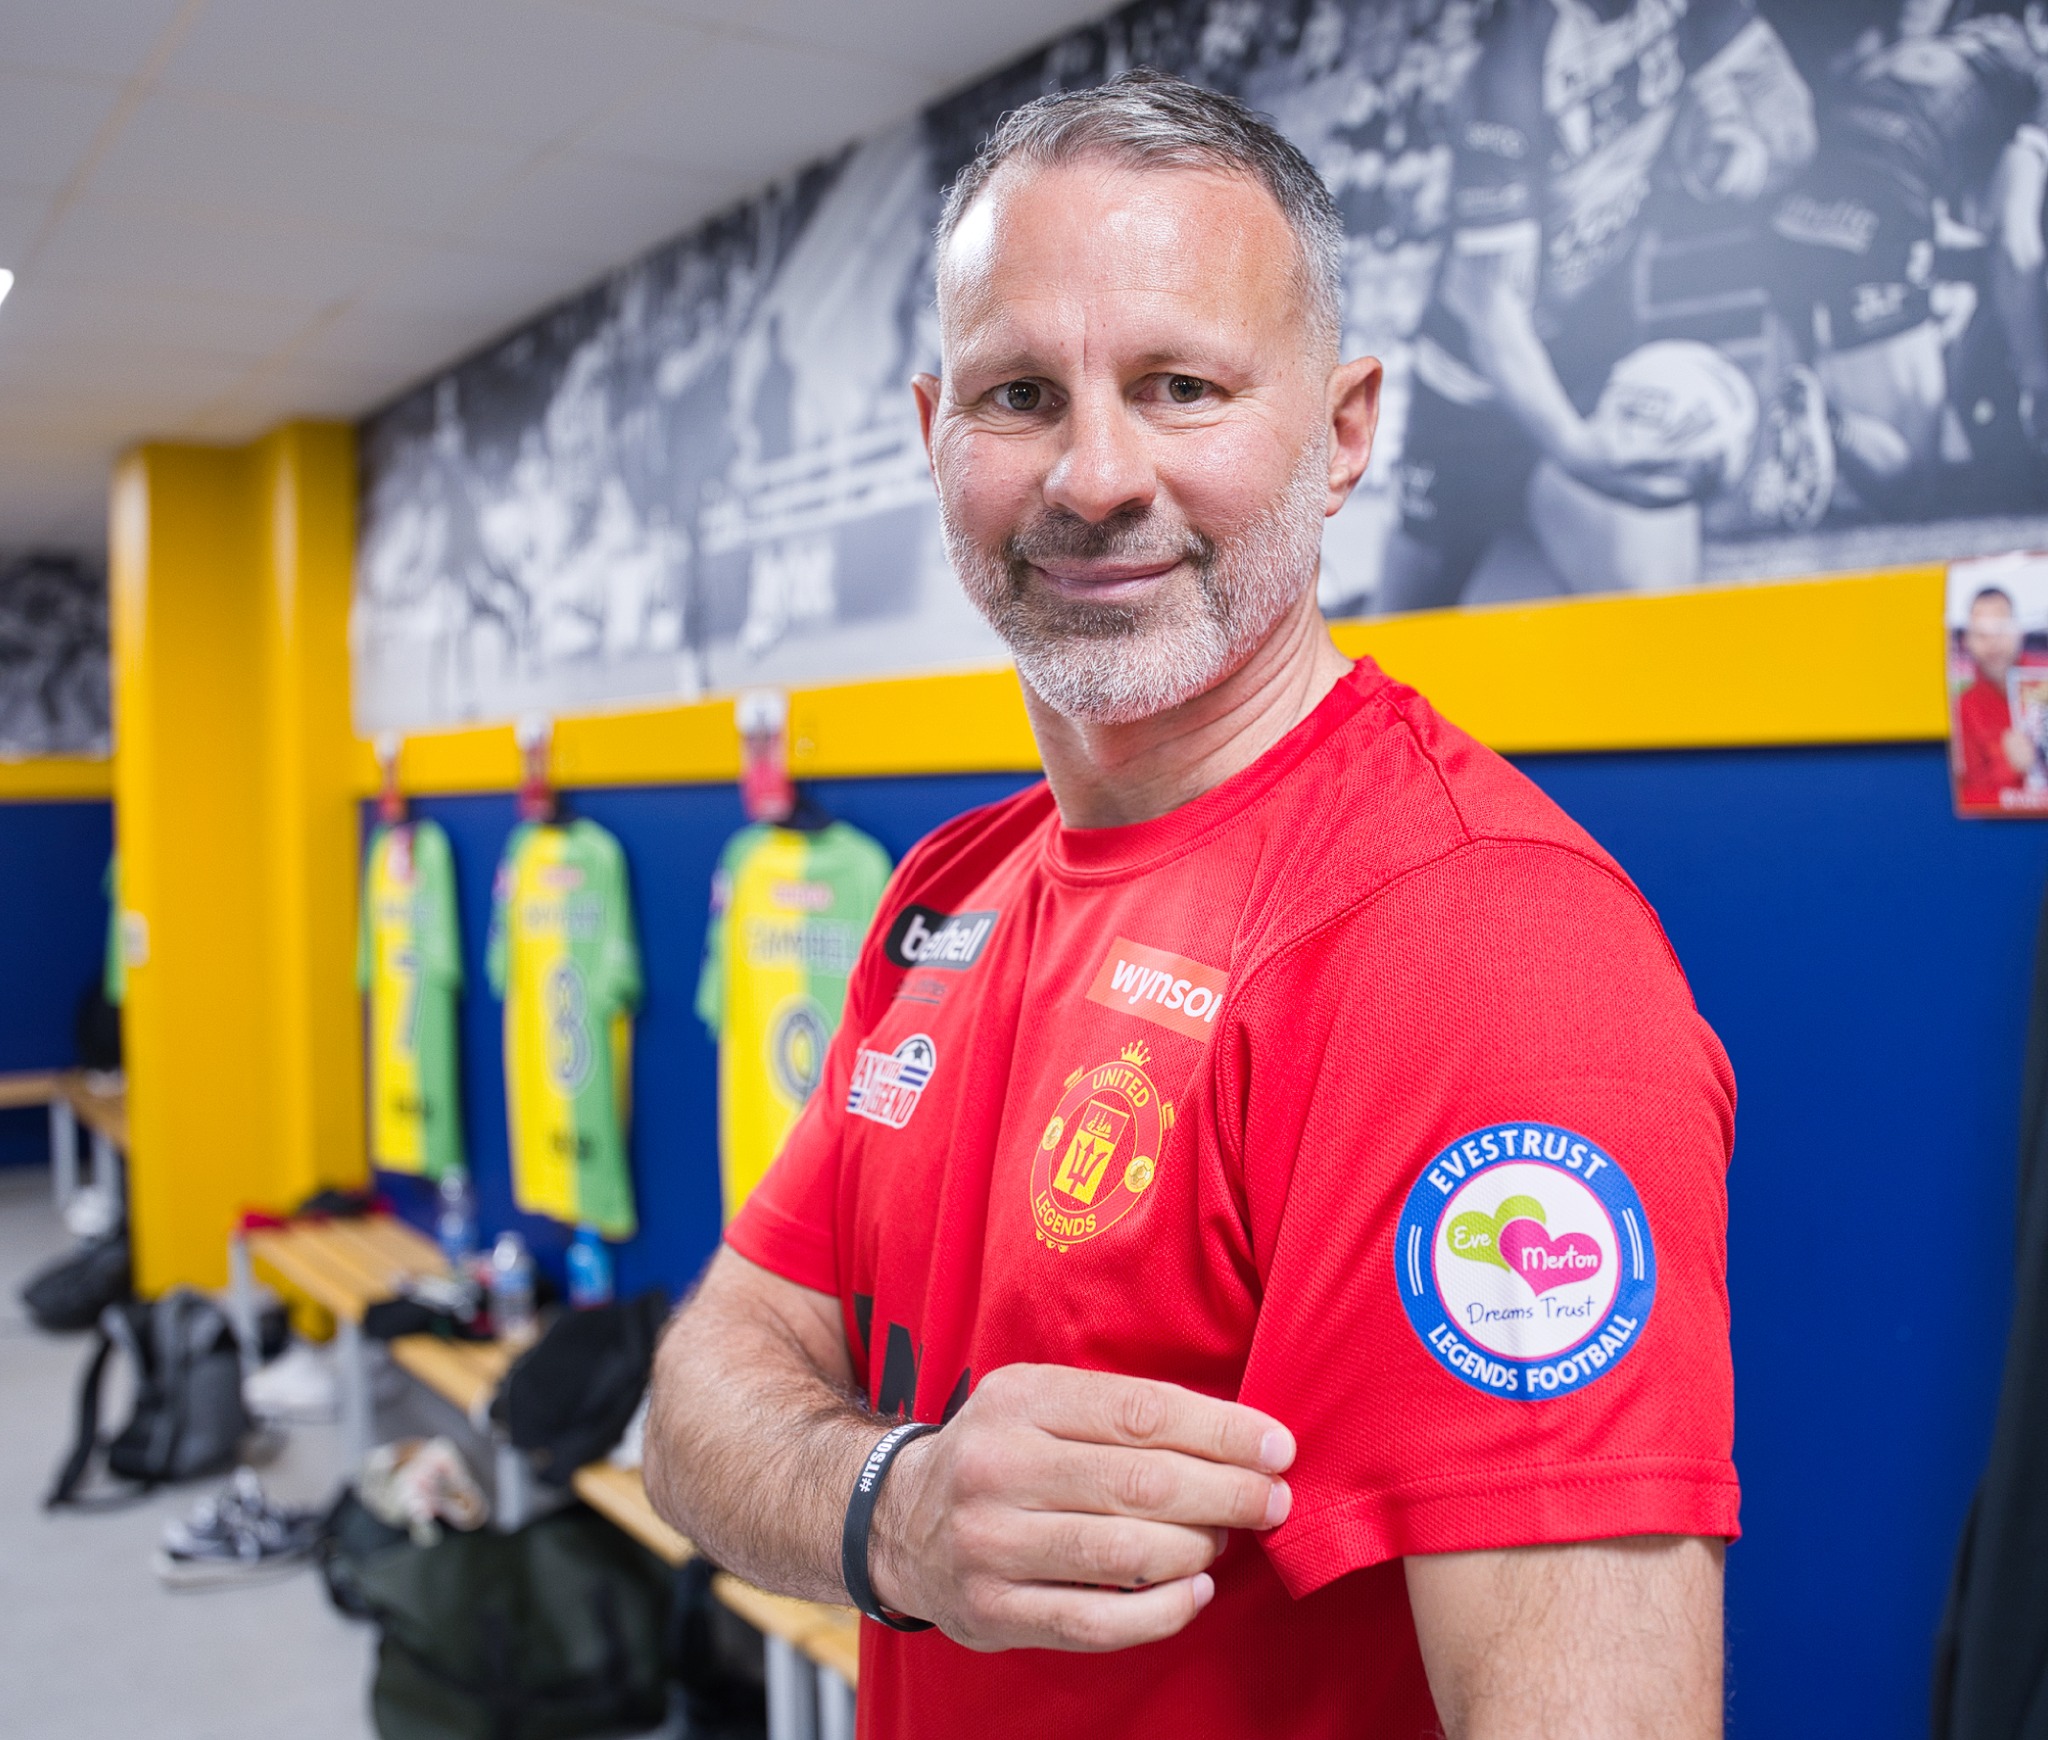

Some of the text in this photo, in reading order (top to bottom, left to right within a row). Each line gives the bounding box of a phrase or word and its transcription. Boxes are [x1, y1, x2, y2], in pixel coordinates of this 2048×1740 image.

[1092, 1067, 1150, 1108] UNITED
[1427, 1128, 1608, 1195] EVESTRUST
[1035, 1189, 1097, 1236] LEGENDS
[1453, 1225, 1492, 1250] Eve
[1521, 1244, 1598, 1271] Merton
[1466, 1295, 1595, 1325] Dreams Trust
[1427, 1314, 1638, 1393] LEGENDS FOOTBALL
